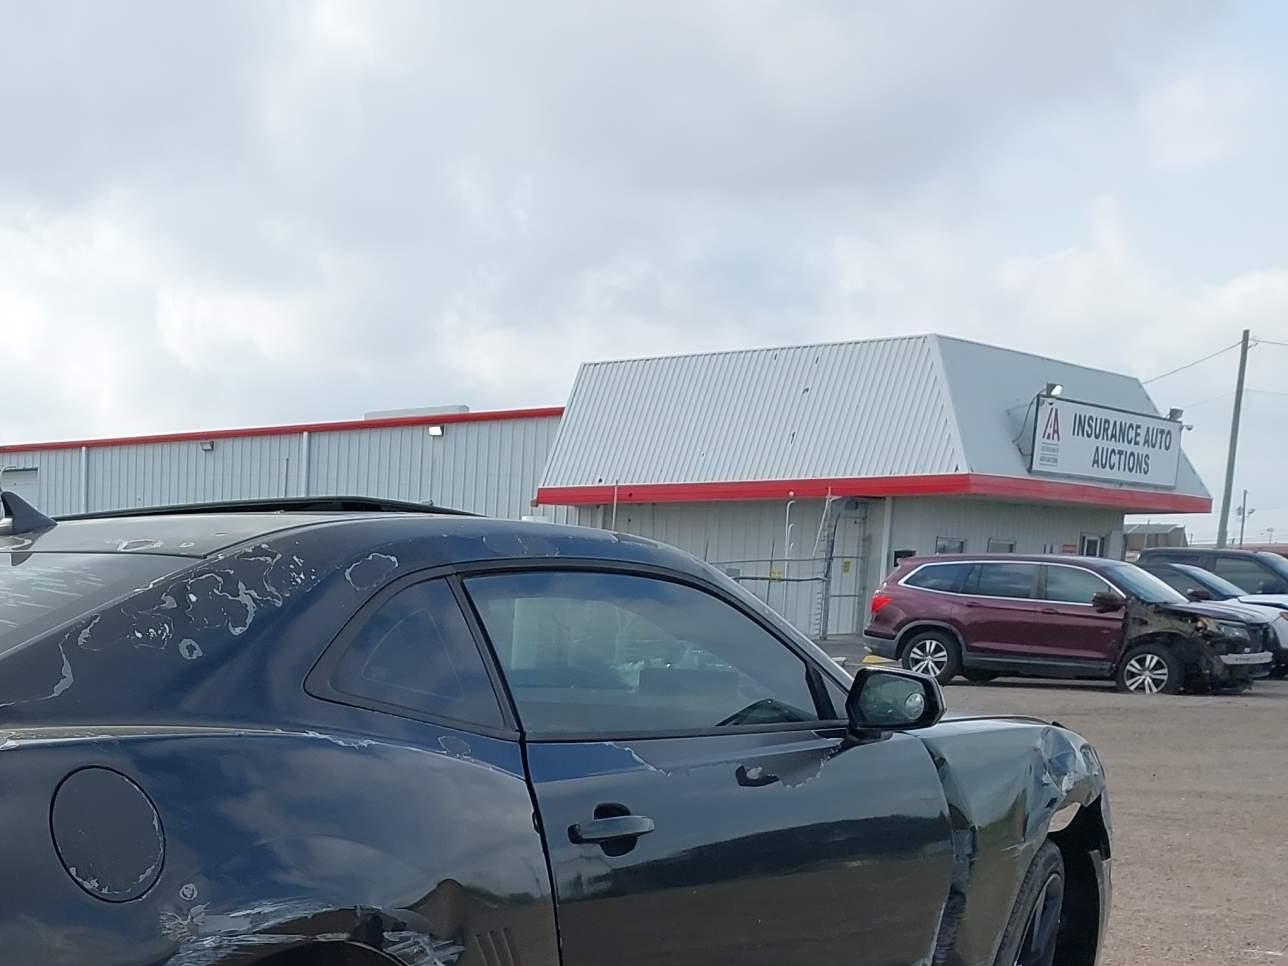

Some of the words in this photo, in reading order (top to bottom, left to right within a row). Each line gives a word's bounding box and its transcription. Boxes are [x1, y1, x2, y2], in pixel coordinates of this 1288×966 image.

[1072, 412, 1141, 446] INSURANCE
[1143, 426, 1172, 451] AUTO
[1092, 446, 1150, 475] AUCTIONS
